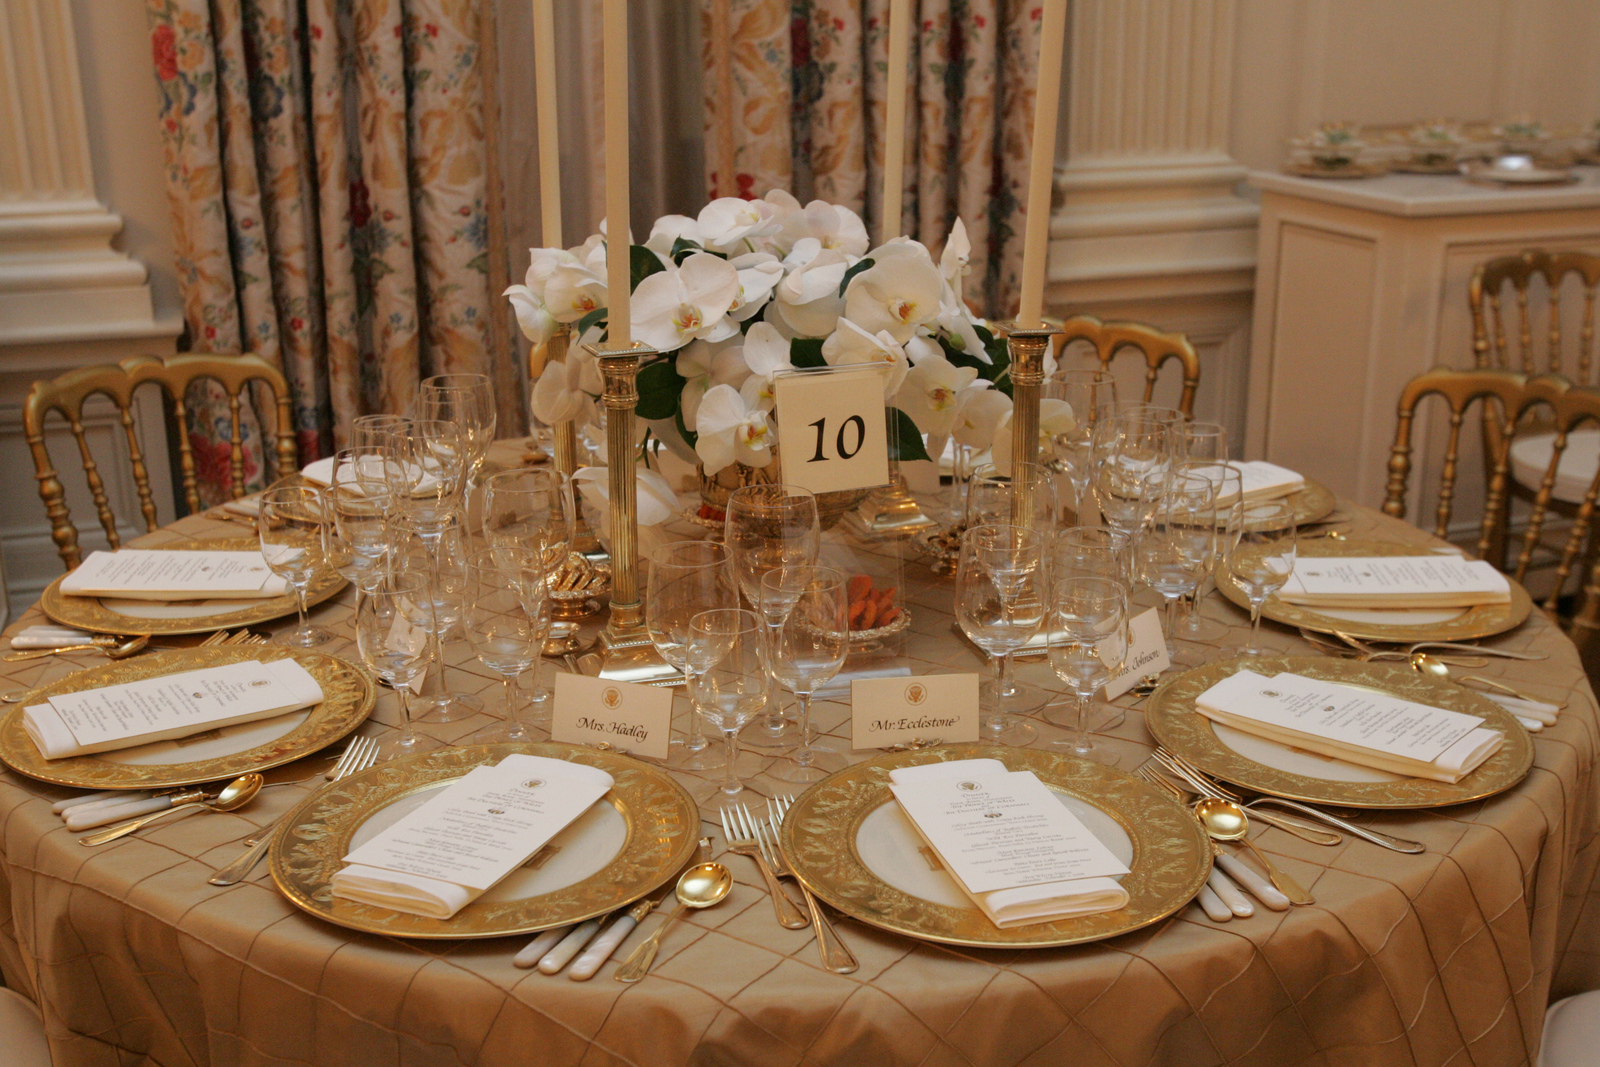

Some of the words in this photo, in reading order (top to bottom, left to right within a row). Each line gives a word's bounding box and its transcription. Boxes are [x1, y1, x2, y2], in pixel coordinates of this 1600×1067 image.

[806, 414, 865, 463] 10
[576, 717, 605, 732] Mrs.
[606, 722, 648, 743] Hadley
[897, 716, 960, 730] Ecclestone
